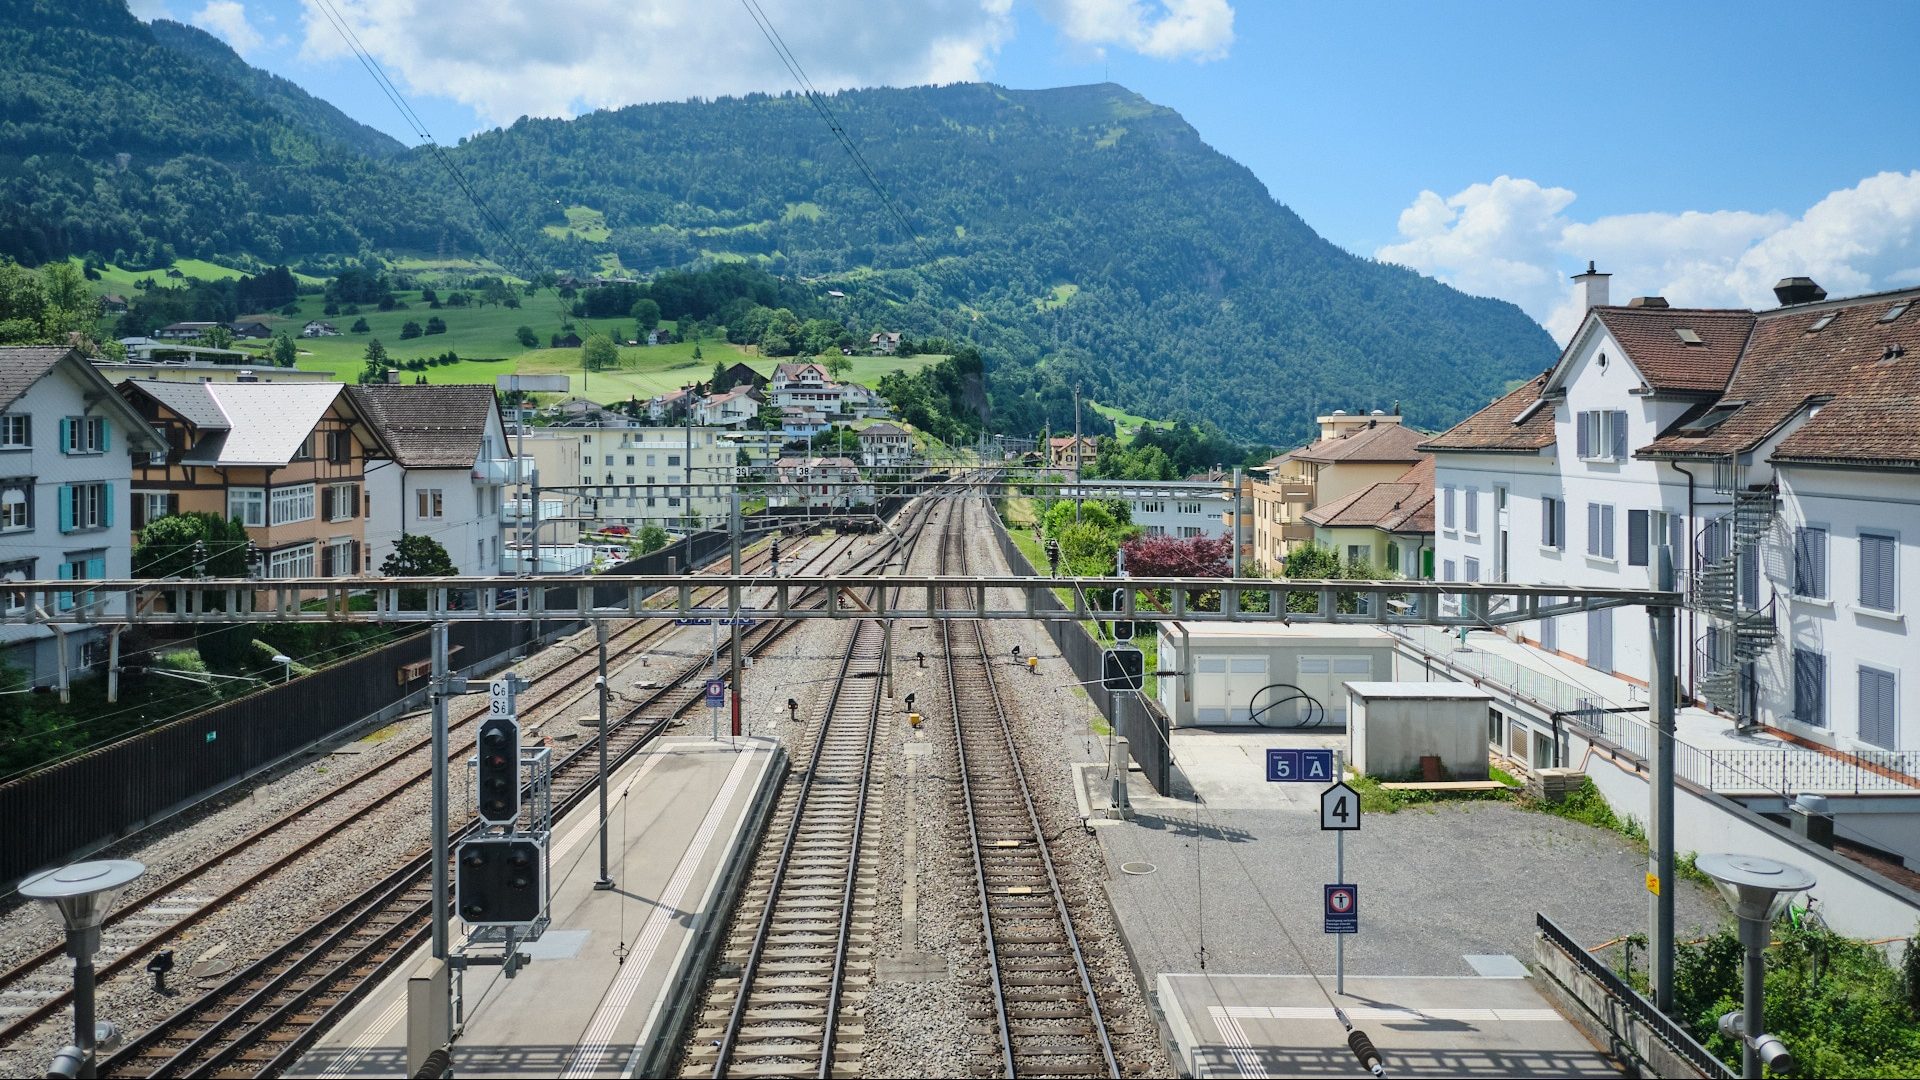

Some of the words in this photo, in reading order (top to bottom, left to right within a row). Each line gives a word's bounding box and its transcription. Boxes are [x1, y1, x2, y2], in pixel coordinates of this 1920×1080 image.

[799, 467, 809, 476] 38
[1277, 761, 1290, 777] 5
[1309, 761, 1324, 777] A
[1332, 795, 1349, 823] 4
